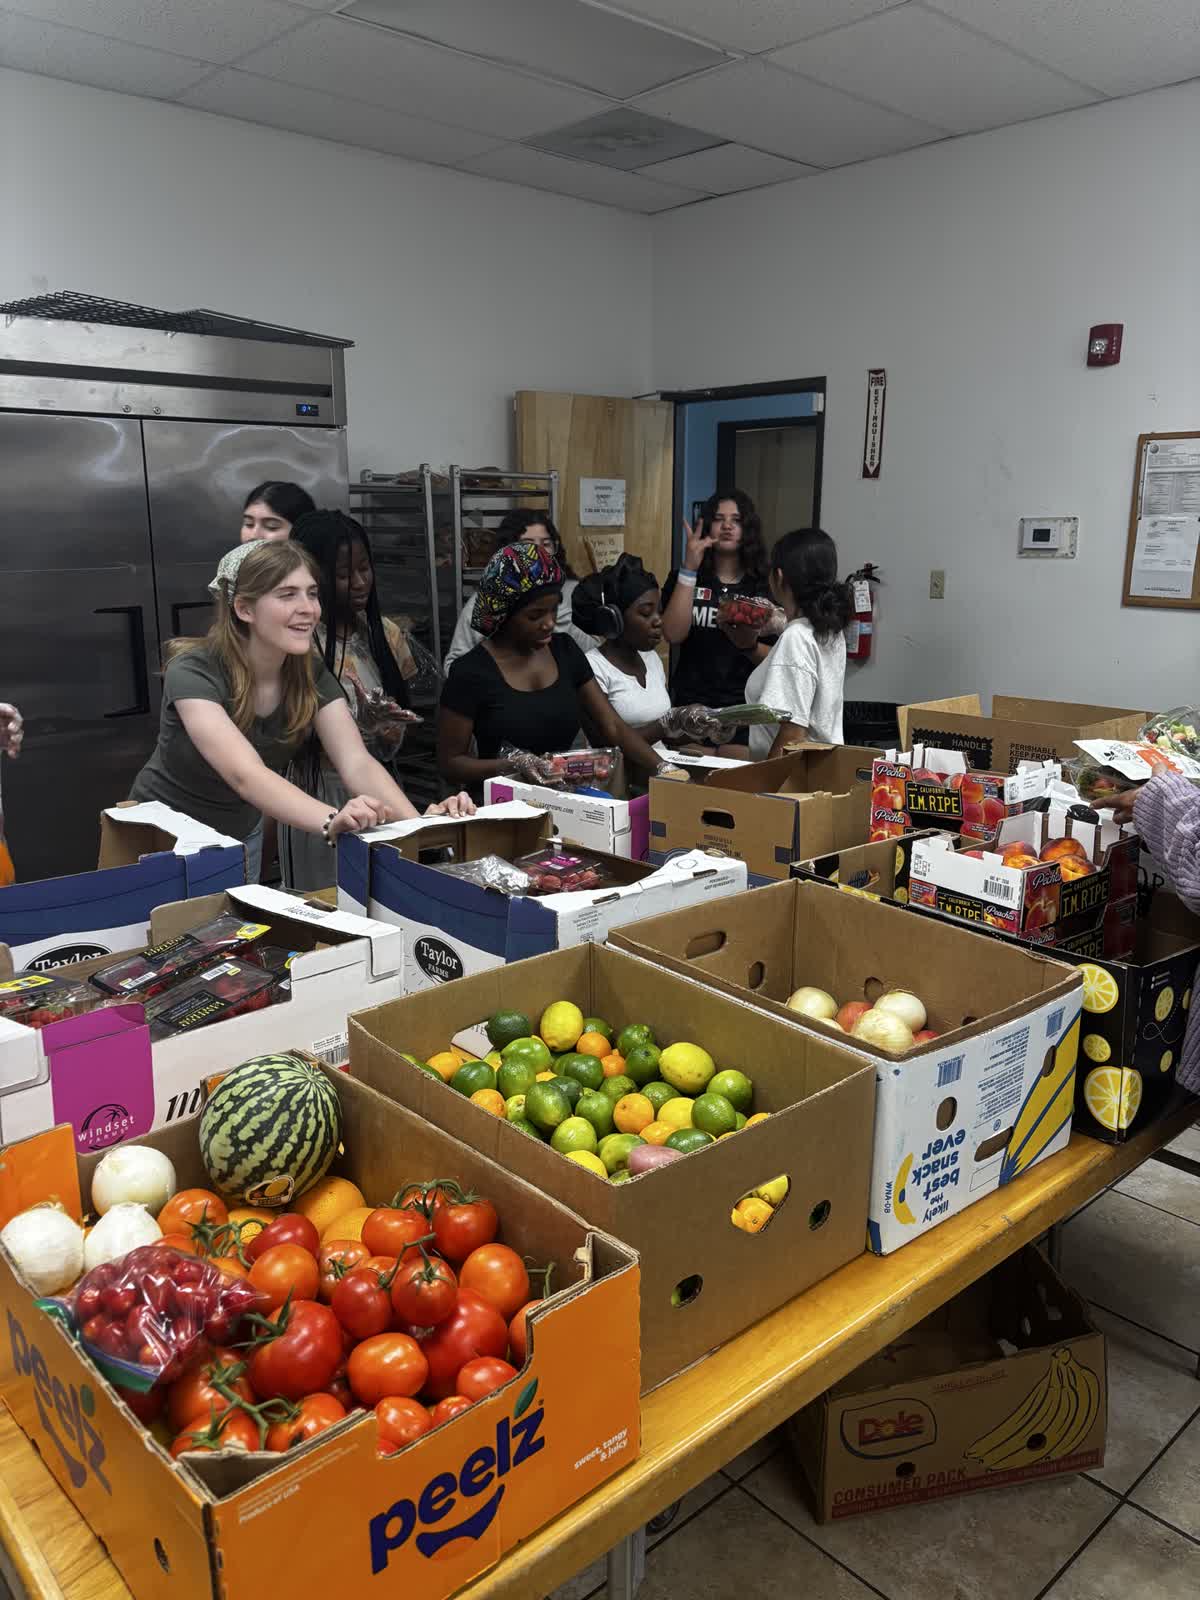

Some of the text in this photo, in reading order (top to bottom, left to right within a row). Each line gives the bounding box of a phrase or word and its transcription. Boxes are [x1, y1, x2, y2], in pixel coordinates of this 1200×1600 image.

[870, 388, 880, 467] EXTINGUISHER
[692, 606, 719, 628] ME
[952, 739, 987, 751] HANDLE
[1009, 750, 1061, 763] KEEP FROZEN
[1010, 743, 1057, 756] PERISHABLE
[986, 905, 1014, 920] Peaches
[420, 941, 458, 970] Taylor
[428, 963, 449, 978] FARMS
[166, 1087, 200, 1122] m
[78, 1116, 135, 1142] windset
[922, 1129, 966, 1160] ever
[911, 1151, 960, 1186] snack
[922, 1168, 960, 1200] best
[930, 1192, 944, 1205] the
[922, 1200, 949, 1224] likely
[7, 1308, 113, 1496] peelz
[858, 1409, 925, 1441] Dole
[600, 1438, 628, 1462] & juicy
[602, 1428, 628, 1449] tangy
[369, 1408, 545, 1575] peelz
[833, 1474, 921, 1504] CONSUMER
[926, 1466, 968, 1490] PACK
